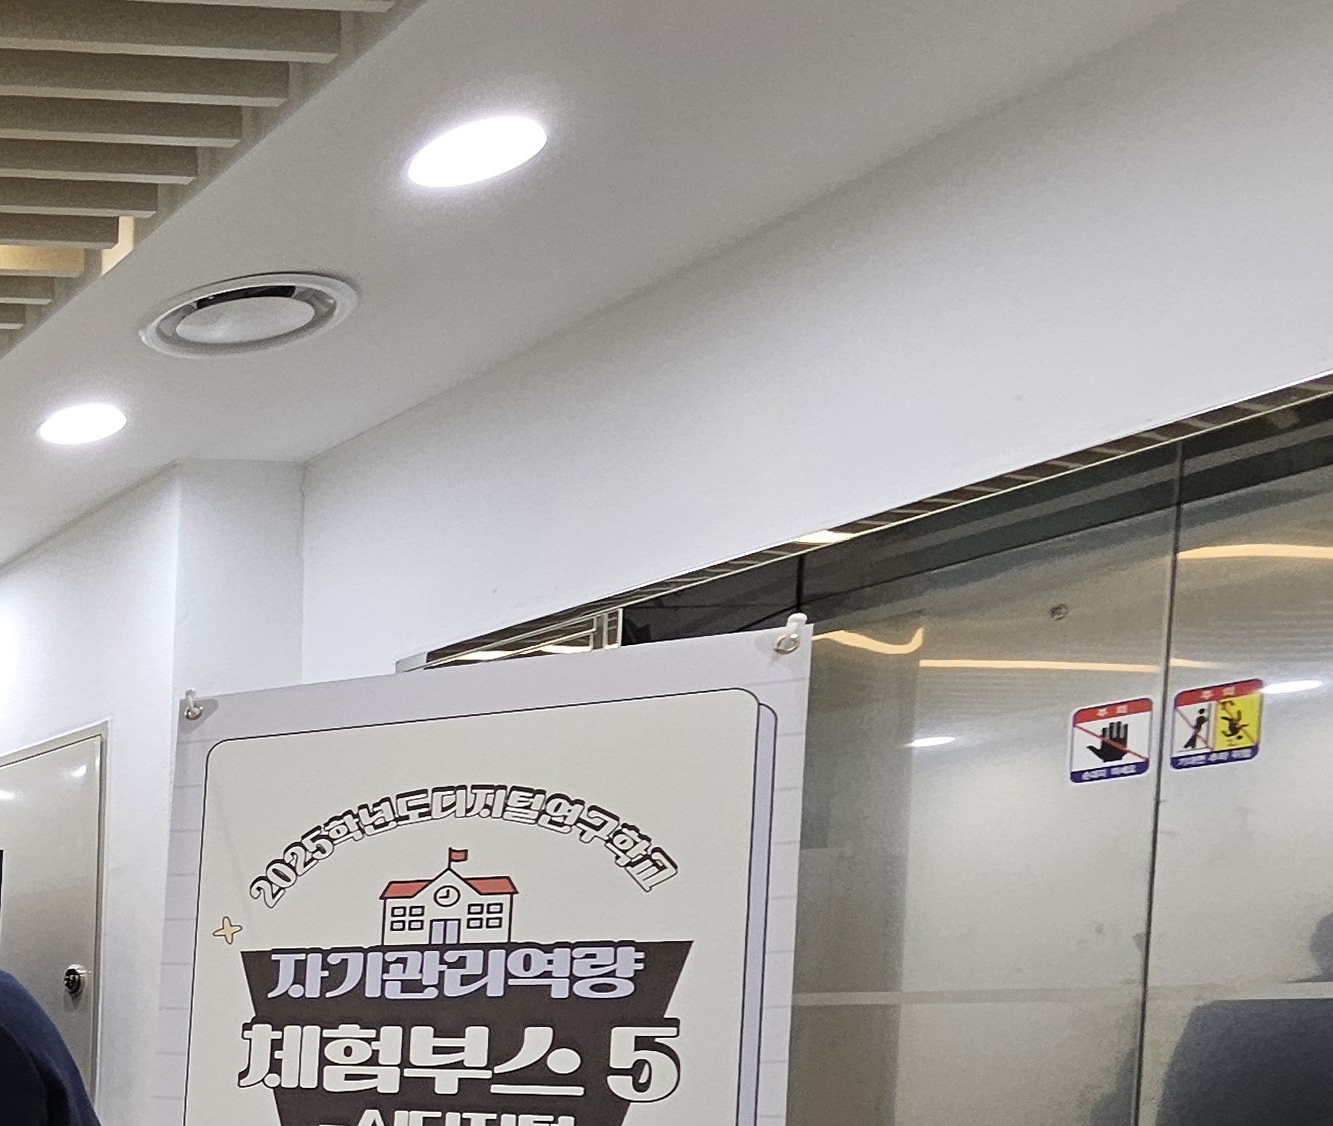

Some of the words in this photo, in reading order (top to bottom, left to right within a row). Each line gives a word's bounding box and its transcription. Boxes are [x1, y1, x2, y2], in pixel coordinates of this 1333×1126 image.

[249, 784, 679, 908] 2025학년도디지털연구학교
[267, 945, 645, 1000] 자기관리역량
[237, 1018, 586, 1097] 체험부스
[605, 1018, 681, 1104] 5
